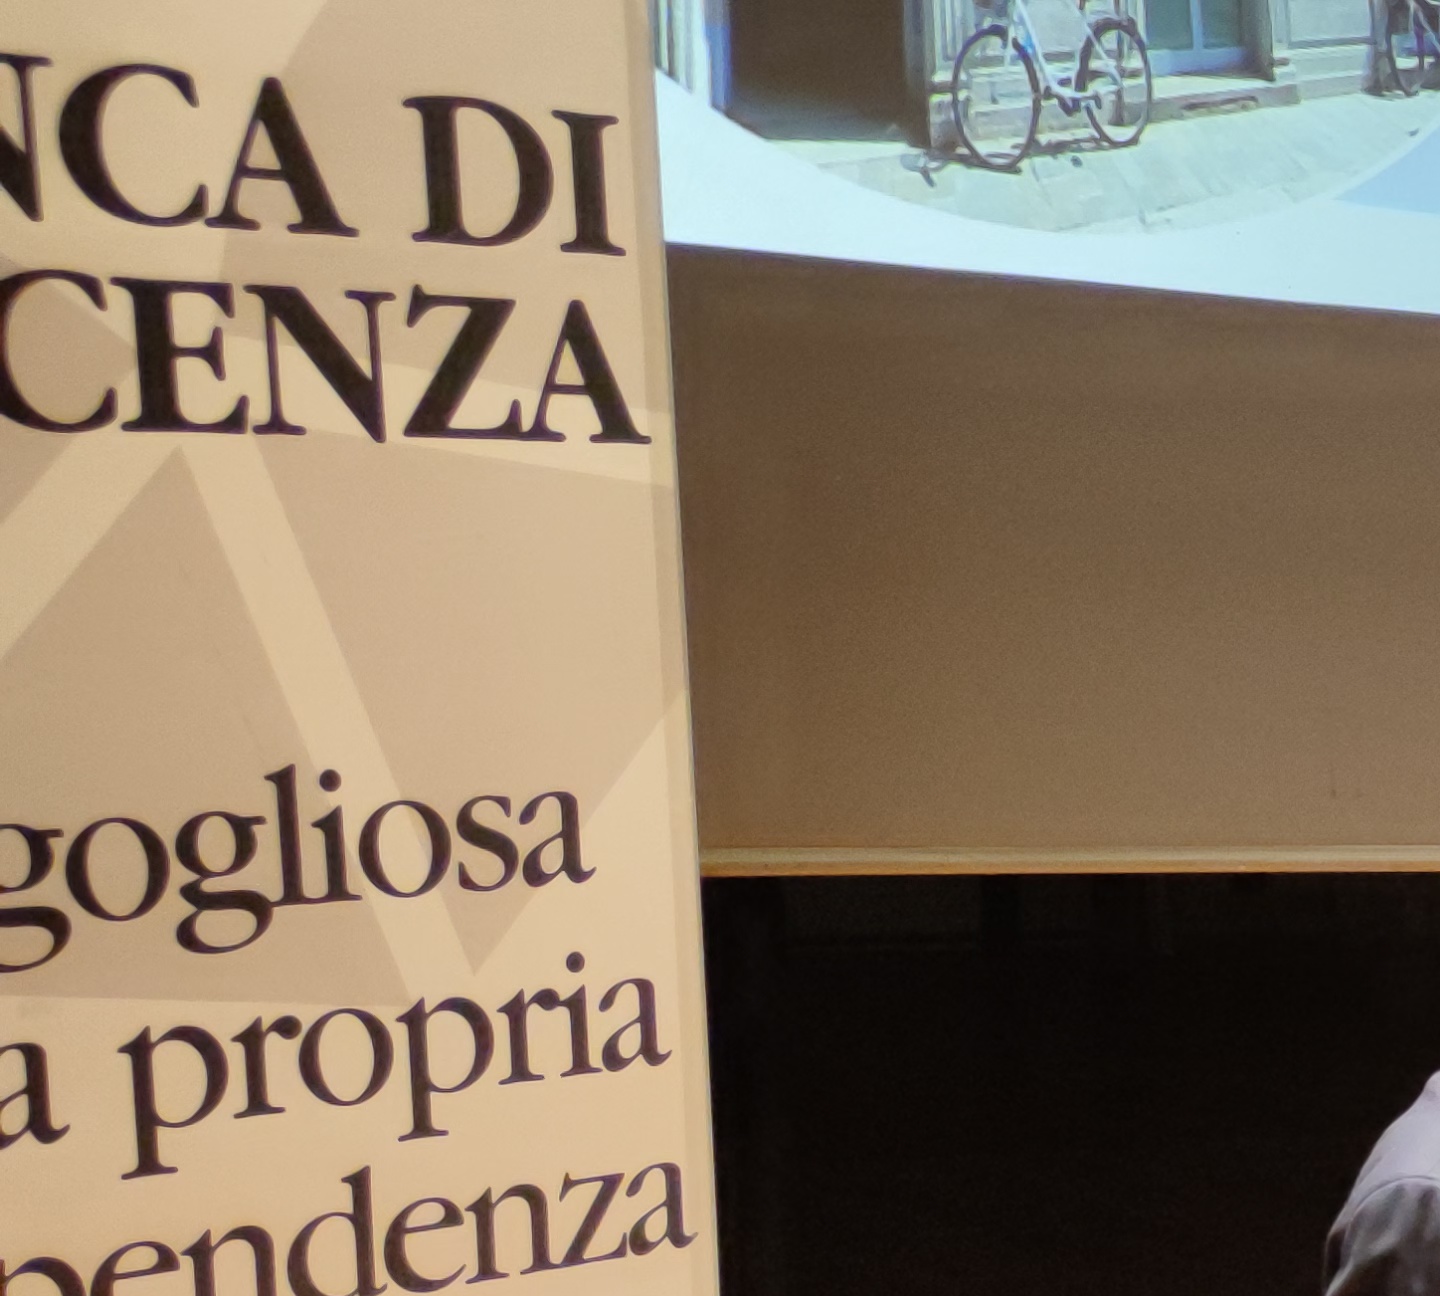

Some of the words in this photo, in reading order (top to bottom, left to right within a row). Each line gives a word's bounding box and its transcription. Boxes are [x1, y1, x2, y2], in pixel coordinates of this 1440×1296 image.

[402, 95, 626, 257] DI
[0, 269, 652, 445] CENZA
[0, 763, 596, 974] gogliosa
[117, 951, 672, 1181] propria
